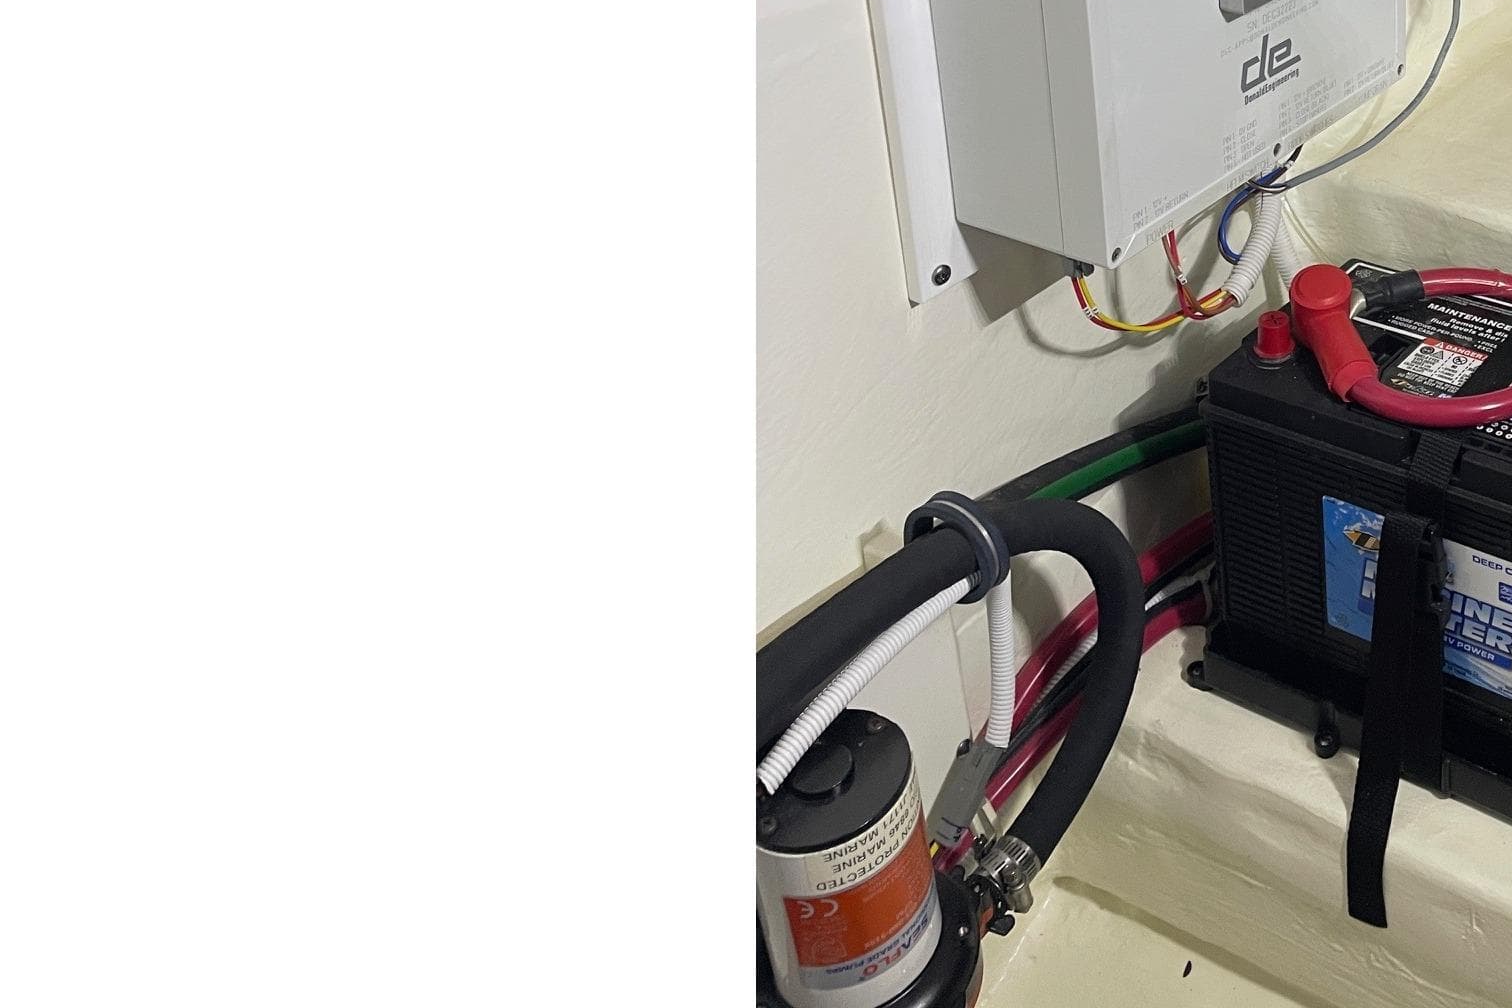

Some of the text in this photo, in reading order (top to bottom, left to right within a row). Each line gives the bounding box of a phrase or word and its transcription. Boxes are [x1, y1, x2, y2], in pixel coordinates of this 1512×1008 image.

[1241, 33, 1302, 94] de
[1244, 68, 1300, 105] DonaldEngineering
[1391, 319, 1418, 333] RUGGED
[1417, 327, 1436, 336] CASE
[1394, 315, 1414, 326] MORE
[1414, 320, 1474, 342] POWER-PER-POUND
[1430, 317, 1450, 329] fluid
[1450, 323, 1477, 336] levels
[1477, 332, 1502, 342] after
[1449, 317, 1485, 332] Remove
[1494, 329, 1510, 339] dis
[1471, 554, 1504, 572] DEEP
[1456, 641, 1496, 661] POWER
[823, 827, 879, 863] MARINE
[832, 837, 886, 874] MARINE
[816, 840, 900, 891] PROTECTED
[862, 911, 929, 978] SEAFLO
